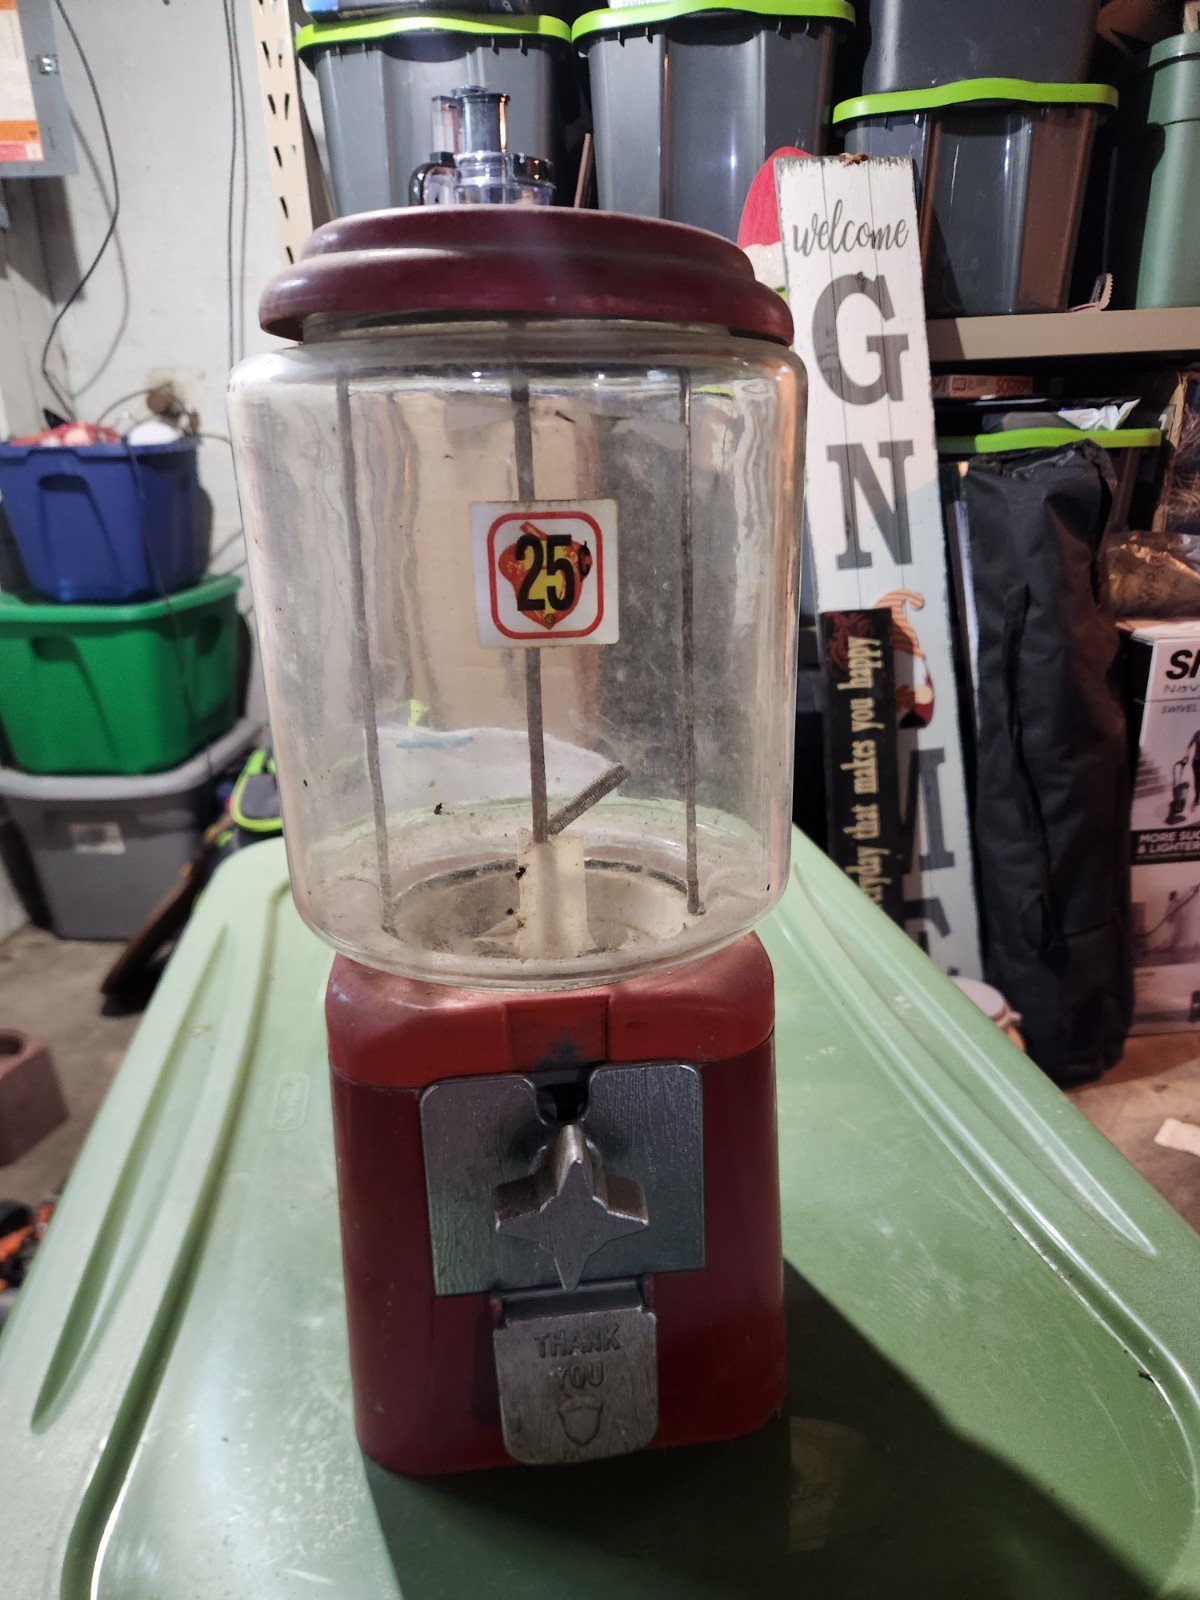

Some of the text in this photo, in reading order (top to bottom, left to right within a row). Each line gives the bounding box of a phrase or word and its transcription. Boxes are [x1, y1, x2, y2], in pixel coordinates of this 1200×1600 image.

[792, 200, 908, 257] welcome
[515, 533, 575, 611] 25
[837, 636, 883, 690] happy
[851, 698, 885, 732] you
[840, 740, 878, 794] makes
[843, 804, 879, 840] that
[1139, 832, 1176, 843] MORE
[534, 1323, 621, 1358] THANK
[550, 1362, 604, 1390] YOU
